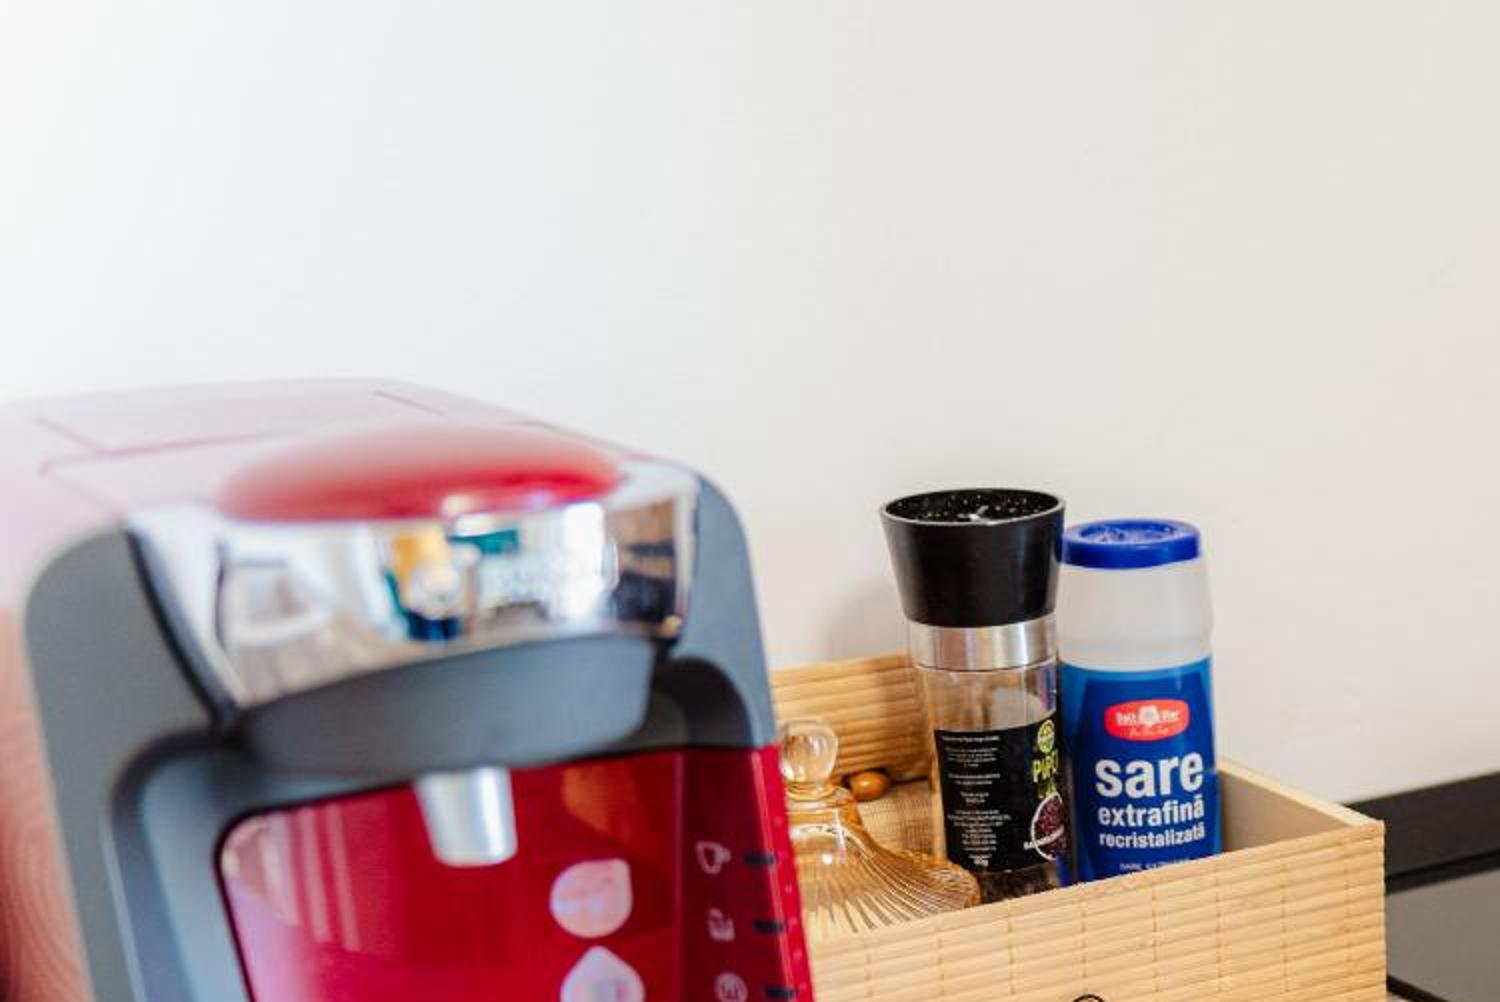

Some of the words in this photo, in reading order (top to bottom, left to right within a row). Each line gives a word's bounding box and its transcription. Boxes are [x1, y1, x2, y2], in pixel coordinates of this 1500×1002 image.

[1095, 752, 1204, 798] sare
[1098, 794, 1205, 827] extrafină
[1099, 822, 1206, 848] recristalizată
